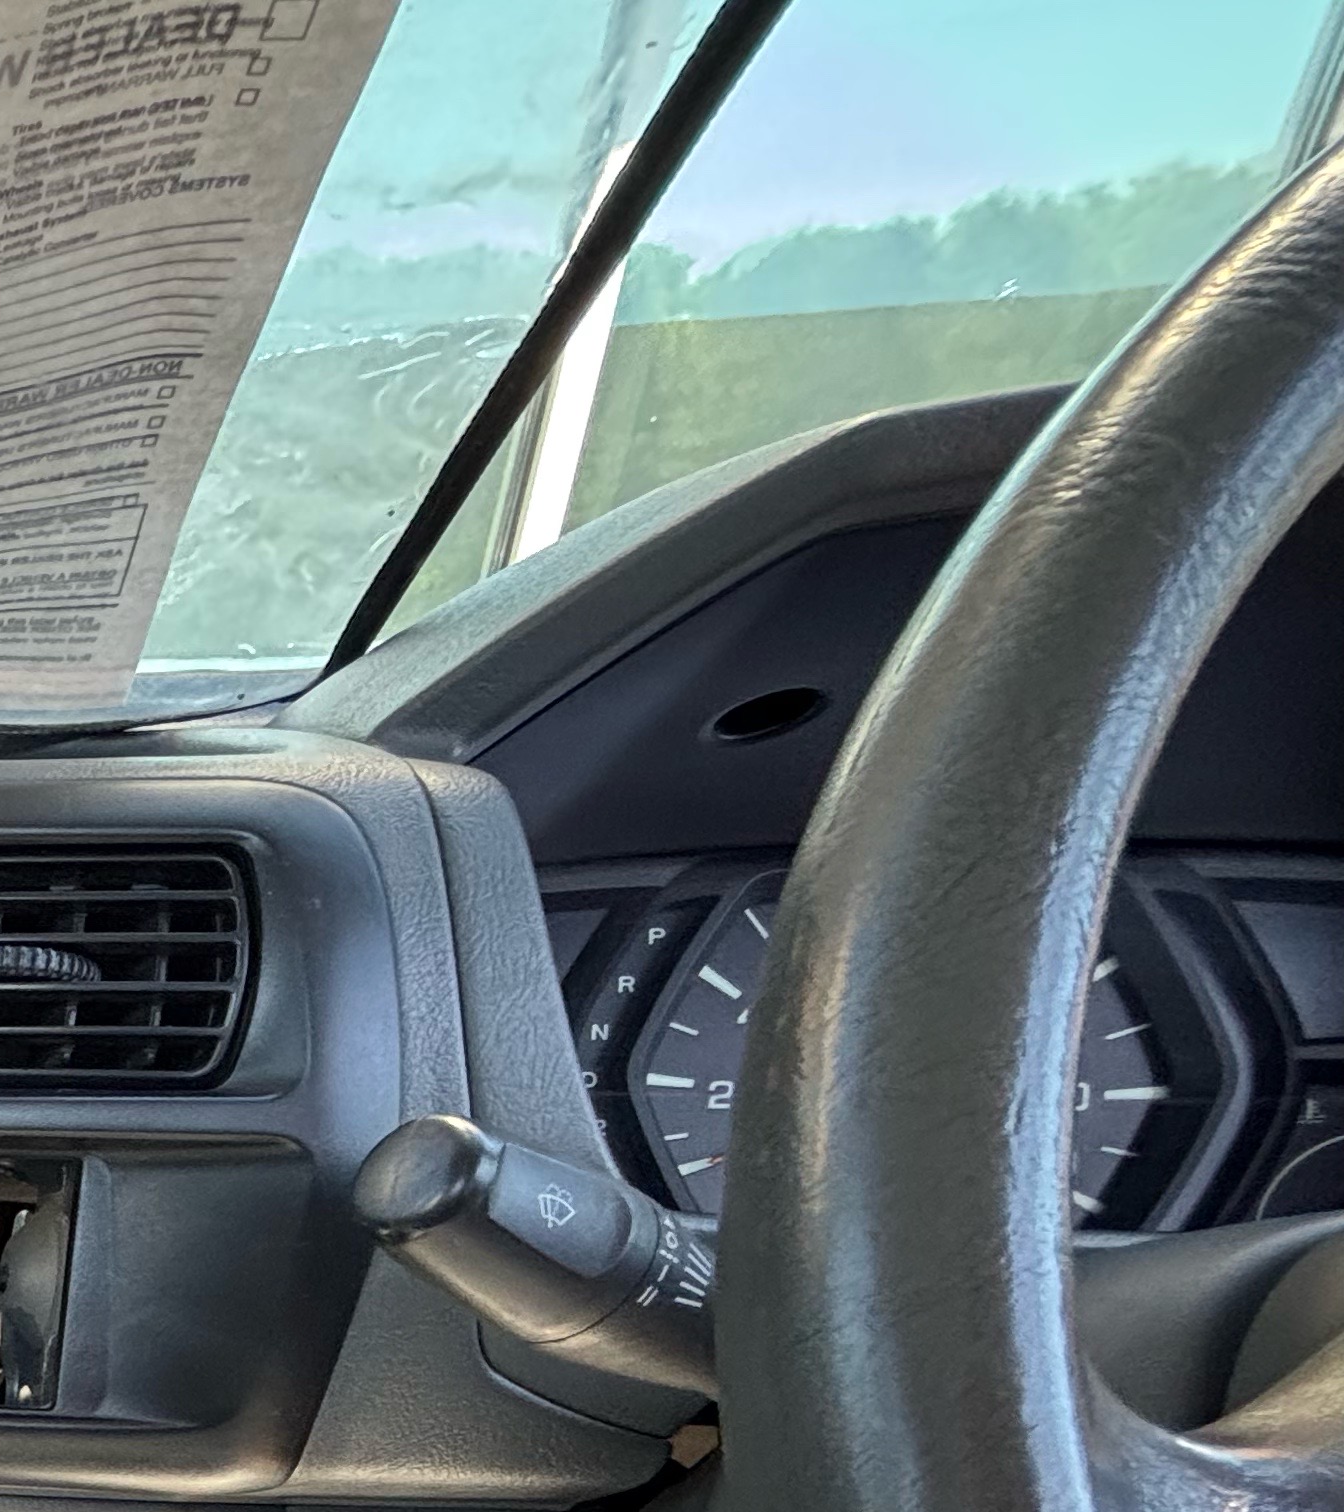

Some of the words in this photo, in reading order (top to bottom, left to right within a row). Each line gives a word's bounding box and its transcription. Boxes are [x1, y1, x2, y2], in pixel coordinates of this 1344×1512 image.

[648, 927, 666, 945] P
[617, 975, 635, 993] R
[590, 1023, 609, 1041] N
